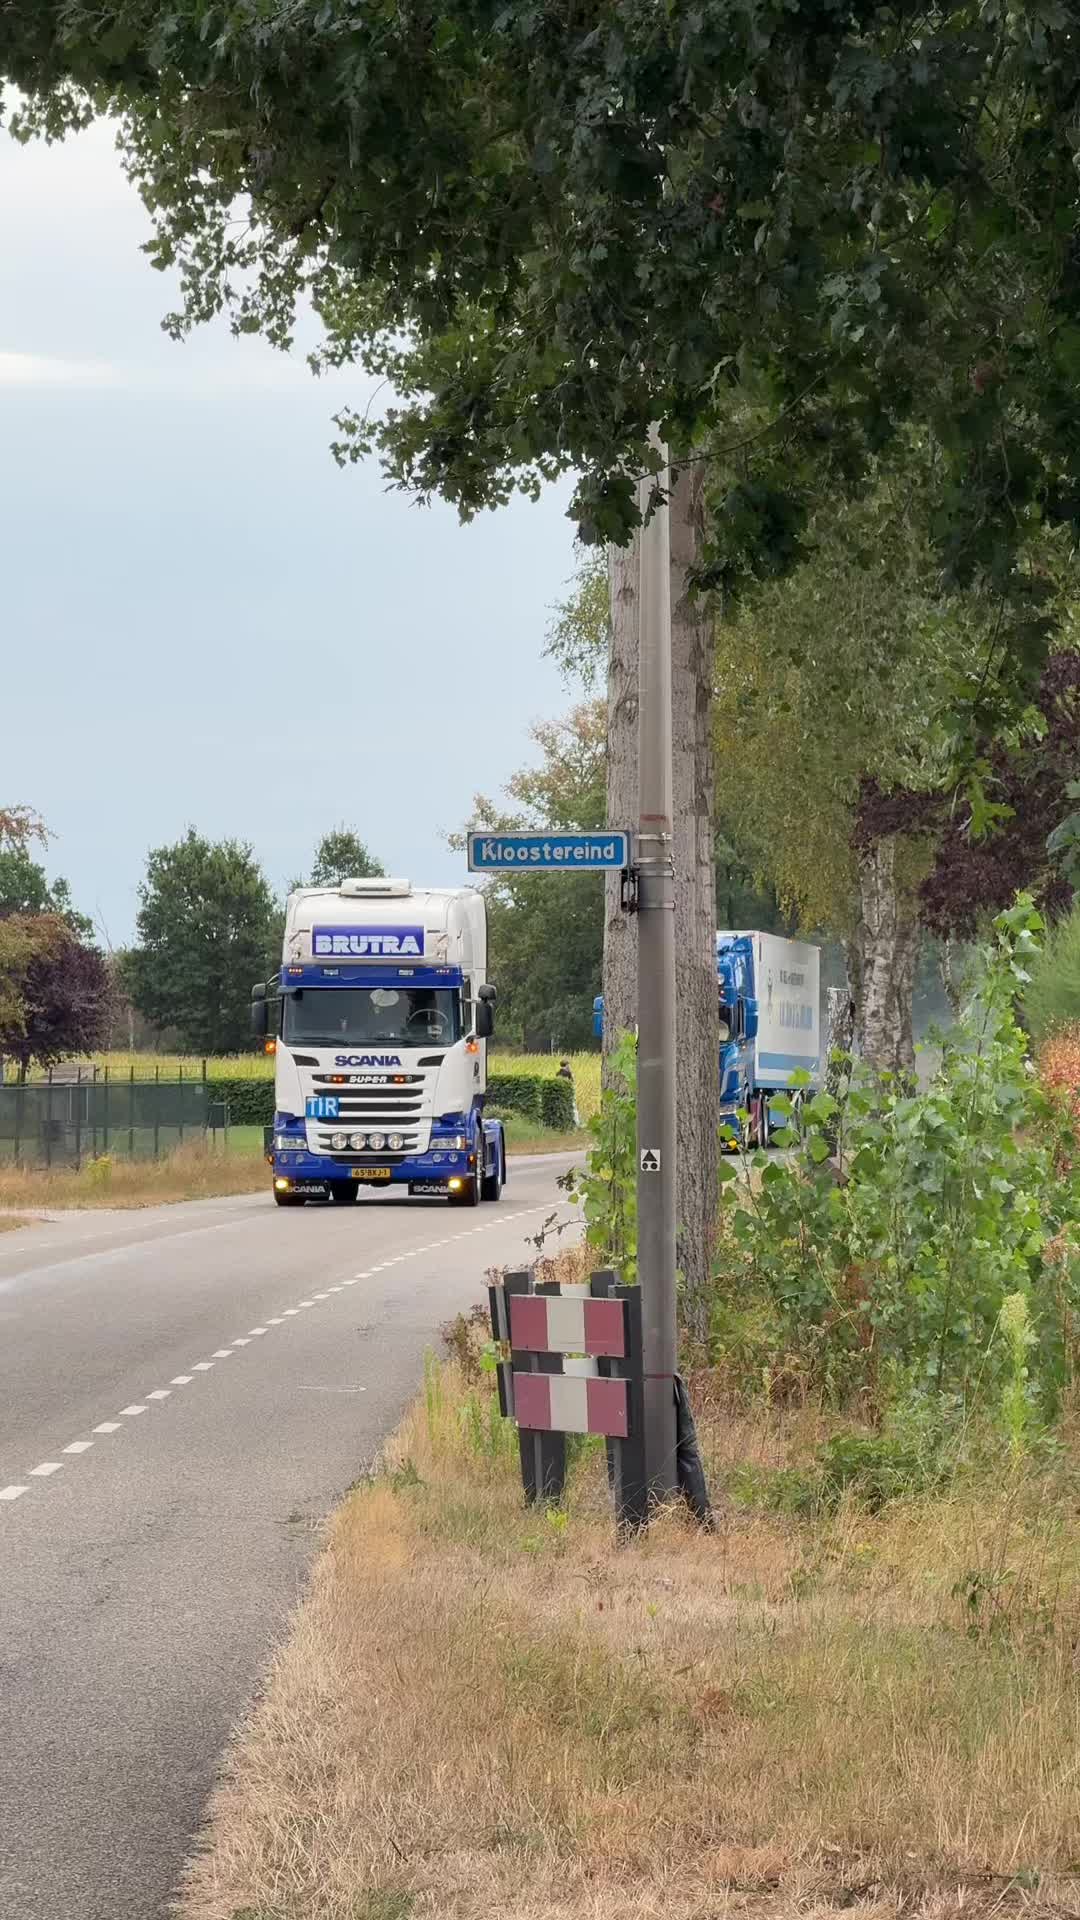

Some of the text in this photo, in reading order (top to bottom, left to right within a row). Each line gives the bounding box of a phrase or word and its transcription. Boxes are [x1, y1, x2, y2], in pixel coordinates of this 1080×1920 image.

[481, 839, 615, 862] Kloostereind
[315, 935, 421, 954] BRUTRA
[334, 1055, 402, 1067] SCANIA
[349, 1075, 388, 1083] SUPER
[308, 1097, 337, 1117] TIR
